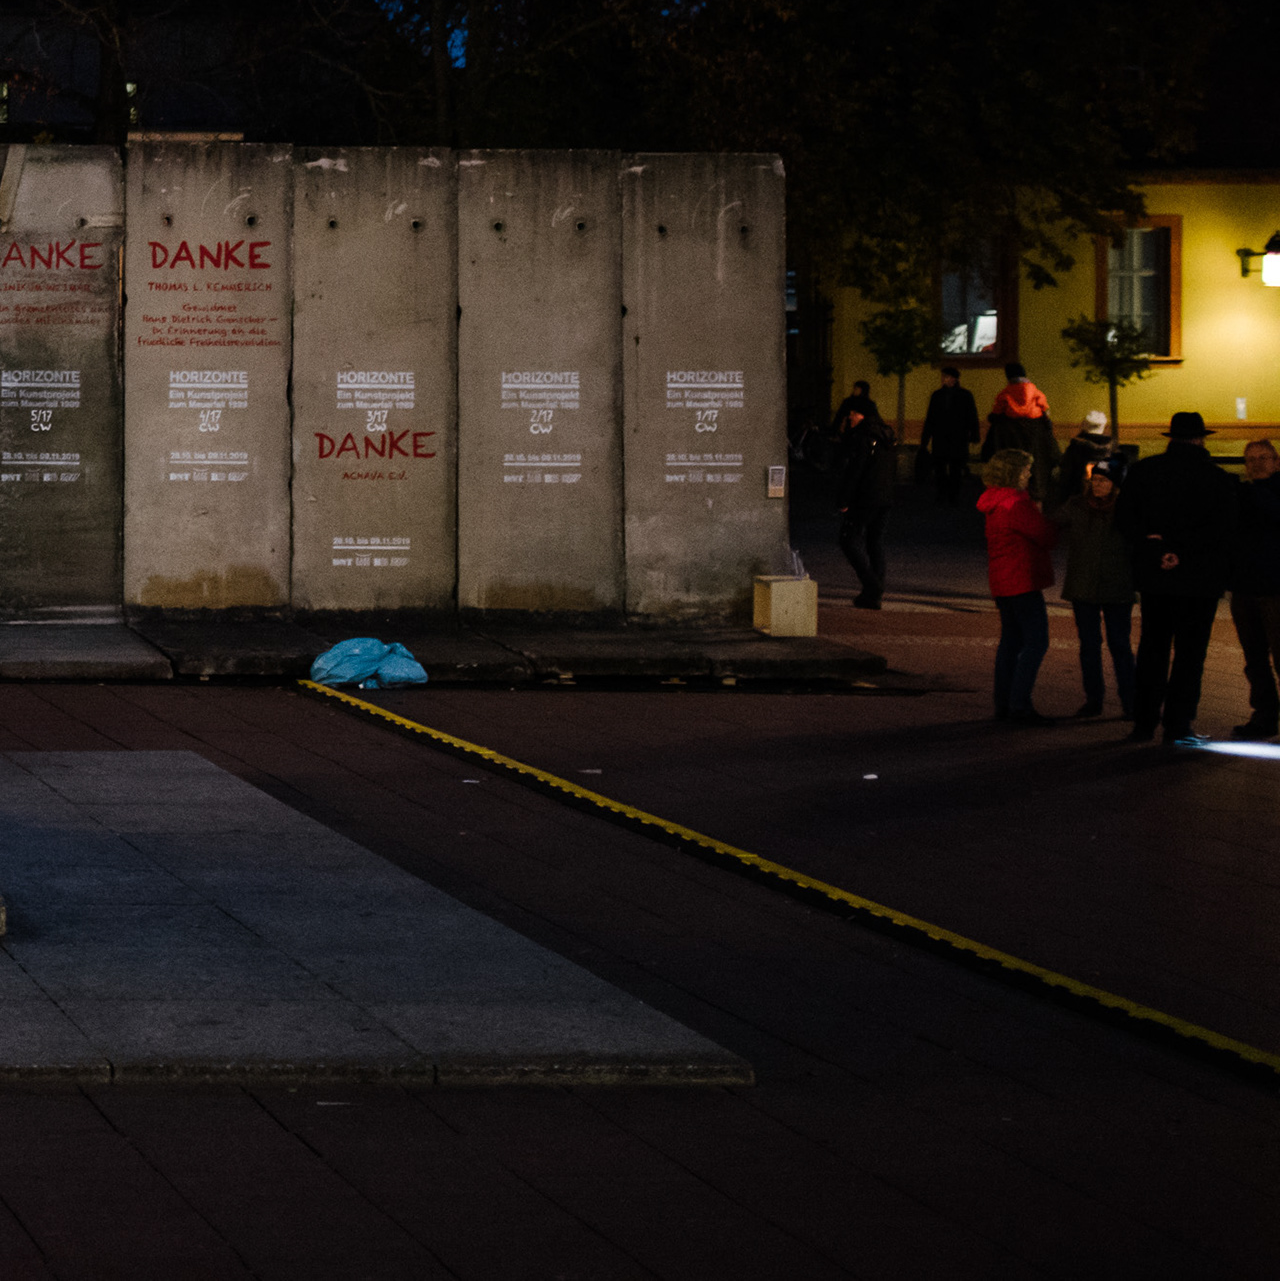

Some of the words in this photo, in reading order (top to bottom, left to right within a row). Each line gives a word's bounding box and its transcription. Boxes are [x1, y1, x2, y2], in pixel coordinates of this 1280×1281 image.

[148, 239, 271, 270] DANKE
[148, 282, 188, 291] THOMAS
[1, 370, 80, 382] HORIZONTE
[170, 371, 248, 383] HORIZONTE
[337, 371, 414, 383] HORIZONTE
[502, 372, 580, 383] HORIZONTE
[667, 371, 743, 382] HORIZONTE
[31, 410, 52, 422] 5/17
[199, 410, 222, 422] 4/17
[367, 410, 388, 422] 3/17
[530, 410, 553, 422] 2/17
[696, 410, 719, 421] 1/17
[31, 423, 52, 431] CW
[199, 423, 220, 432] CW
[367, 422, 387, 432] CW
[530, 423, 553, 434] CW
[695, 422, 717, 433] CW
[314, 429, 436, 459] DANKE
[343, 472, 384, 480] ACHAVA
